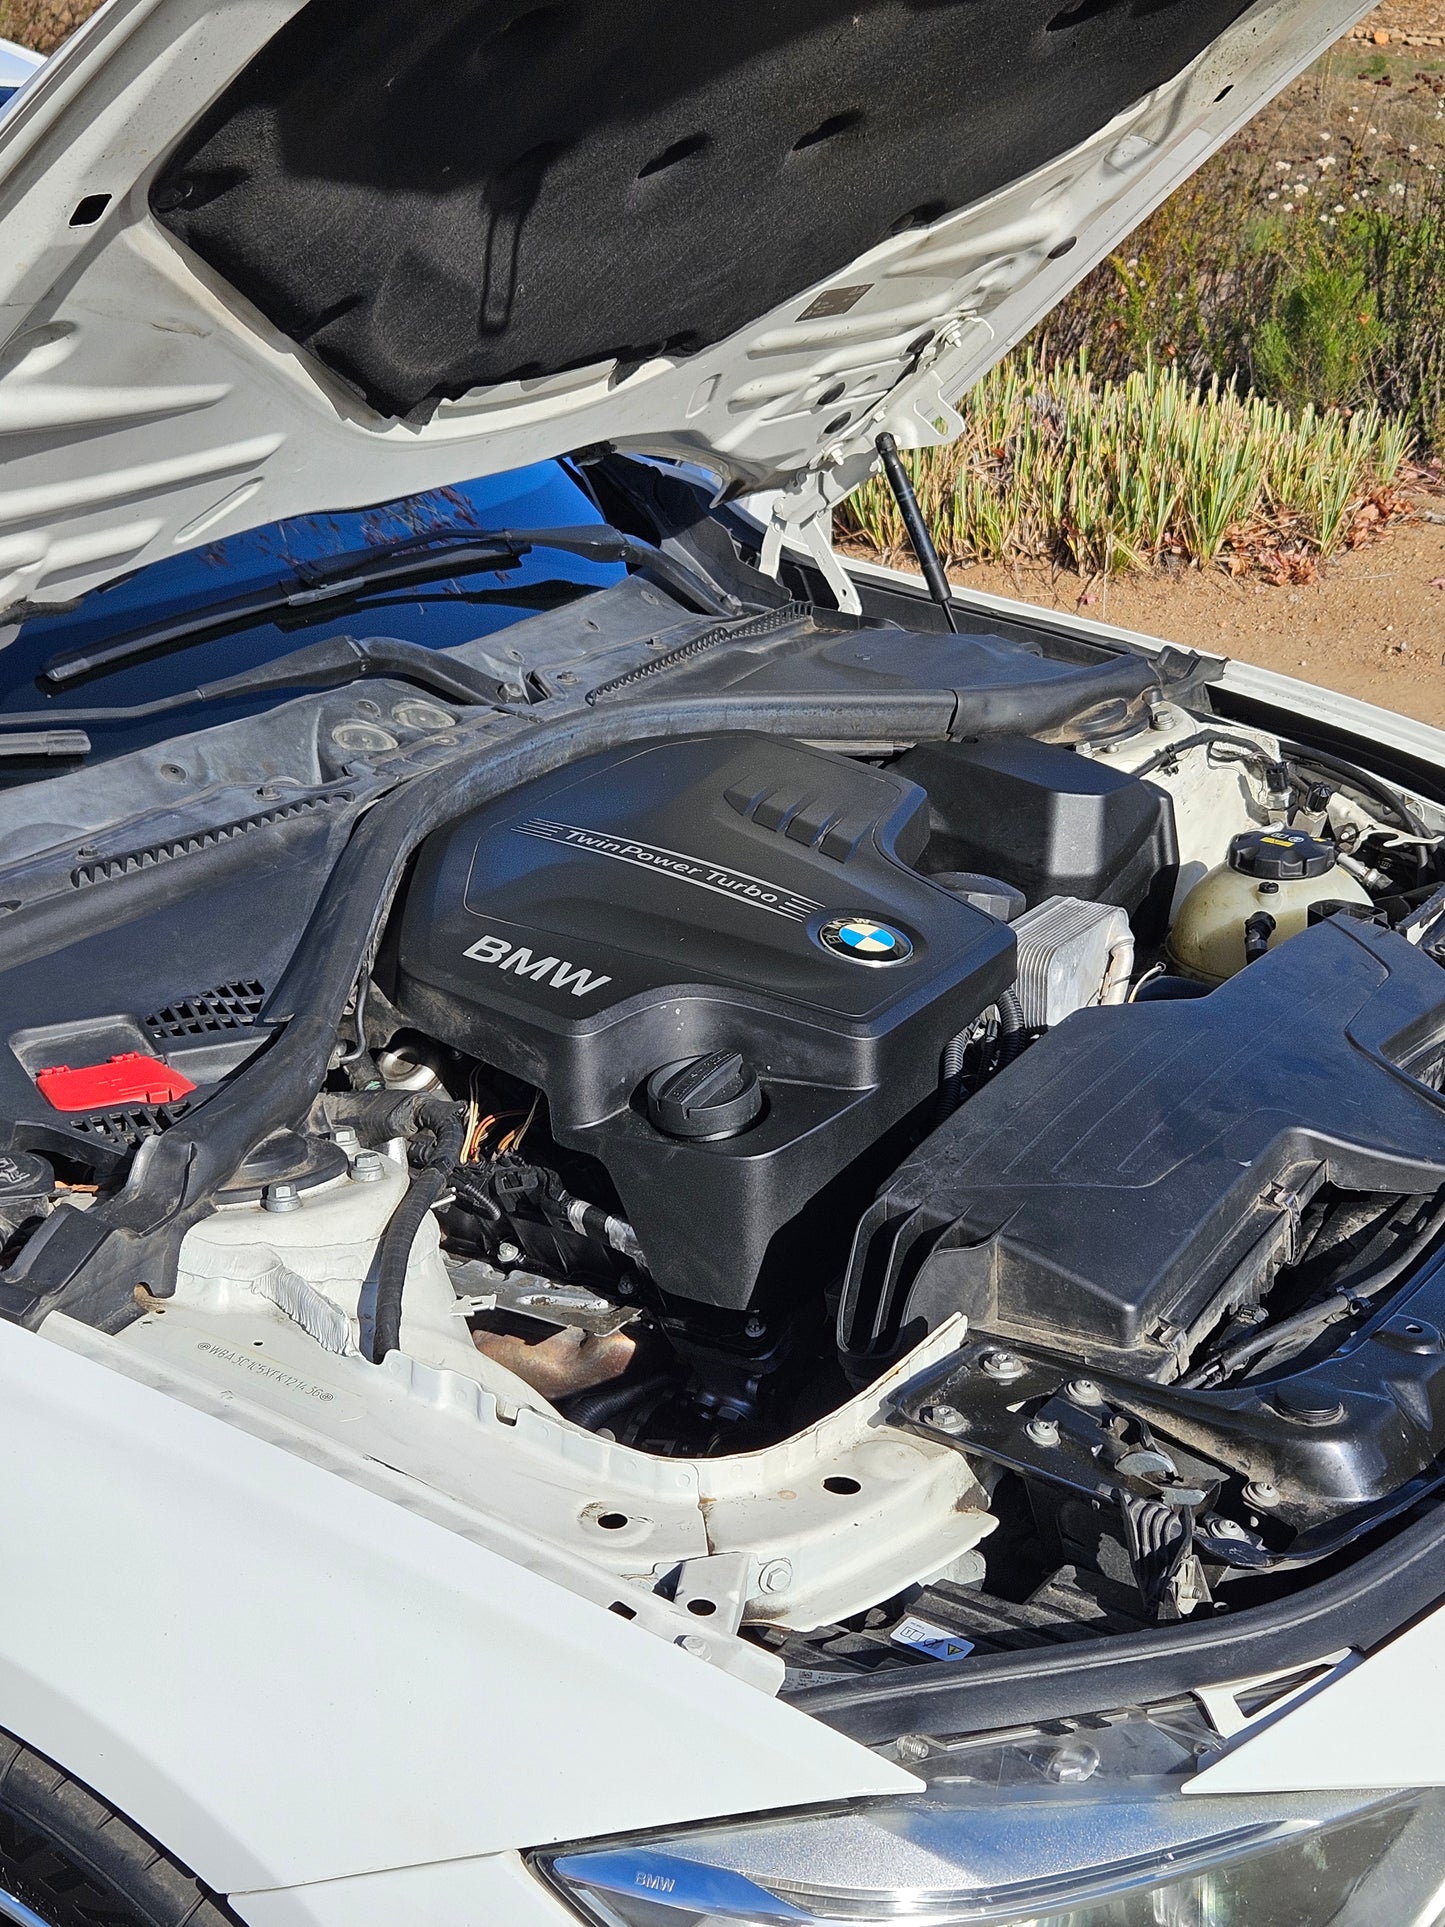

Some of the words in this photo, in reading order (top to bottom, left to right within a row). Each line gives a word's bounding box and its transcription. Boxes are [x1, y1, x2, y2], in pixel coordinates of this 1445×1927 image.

[705, 869, 778, 904] Turbo
[462, 934, 612, 997] BMW
[634, 1871, 676, 1893] BMW
